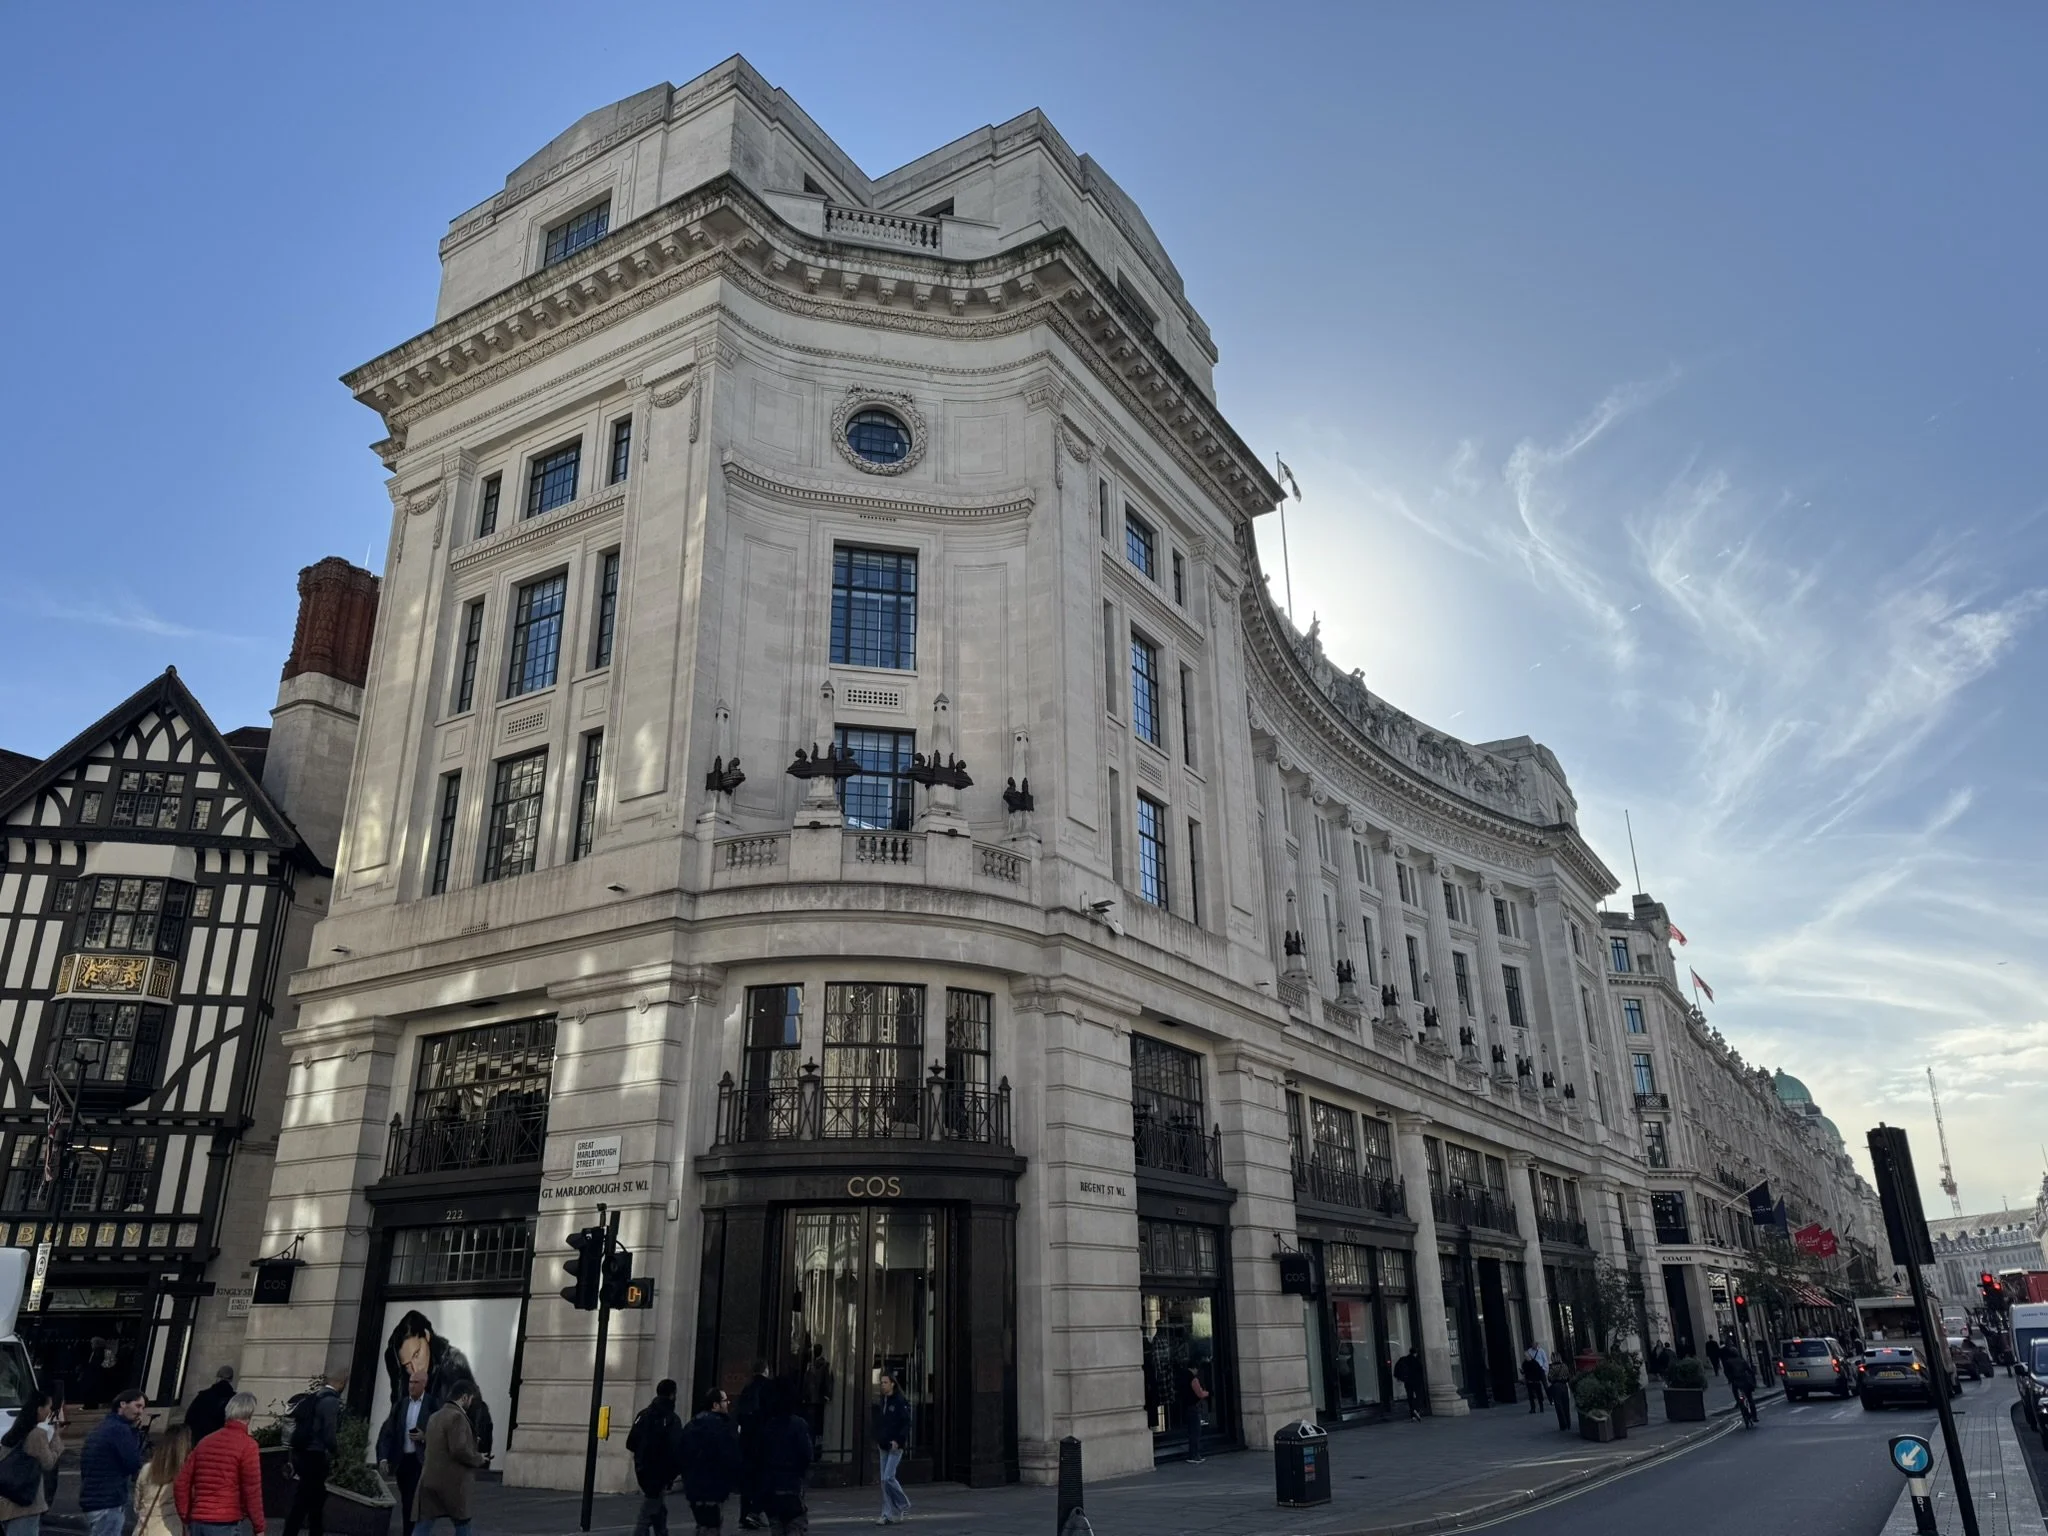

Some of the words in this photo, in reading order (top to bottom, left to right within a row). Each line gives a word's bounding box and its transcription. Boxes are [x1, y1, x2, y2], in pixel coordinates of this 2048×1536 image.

[578, 1141, 594, 1151] GREAT
[576, 1148, 617, 1159] MARLBOROUGH
[576, 1159, 595, 1168] STREET
[555, 1182, 620, 1198] MARLBOROUGH
[847, 1176, 901, 1197] COS
[1080, 1181, 1106, 1195] REGENT
[1285, 1272, 1305, 1282] COS
[263, 1280, 287, 1290] COS
